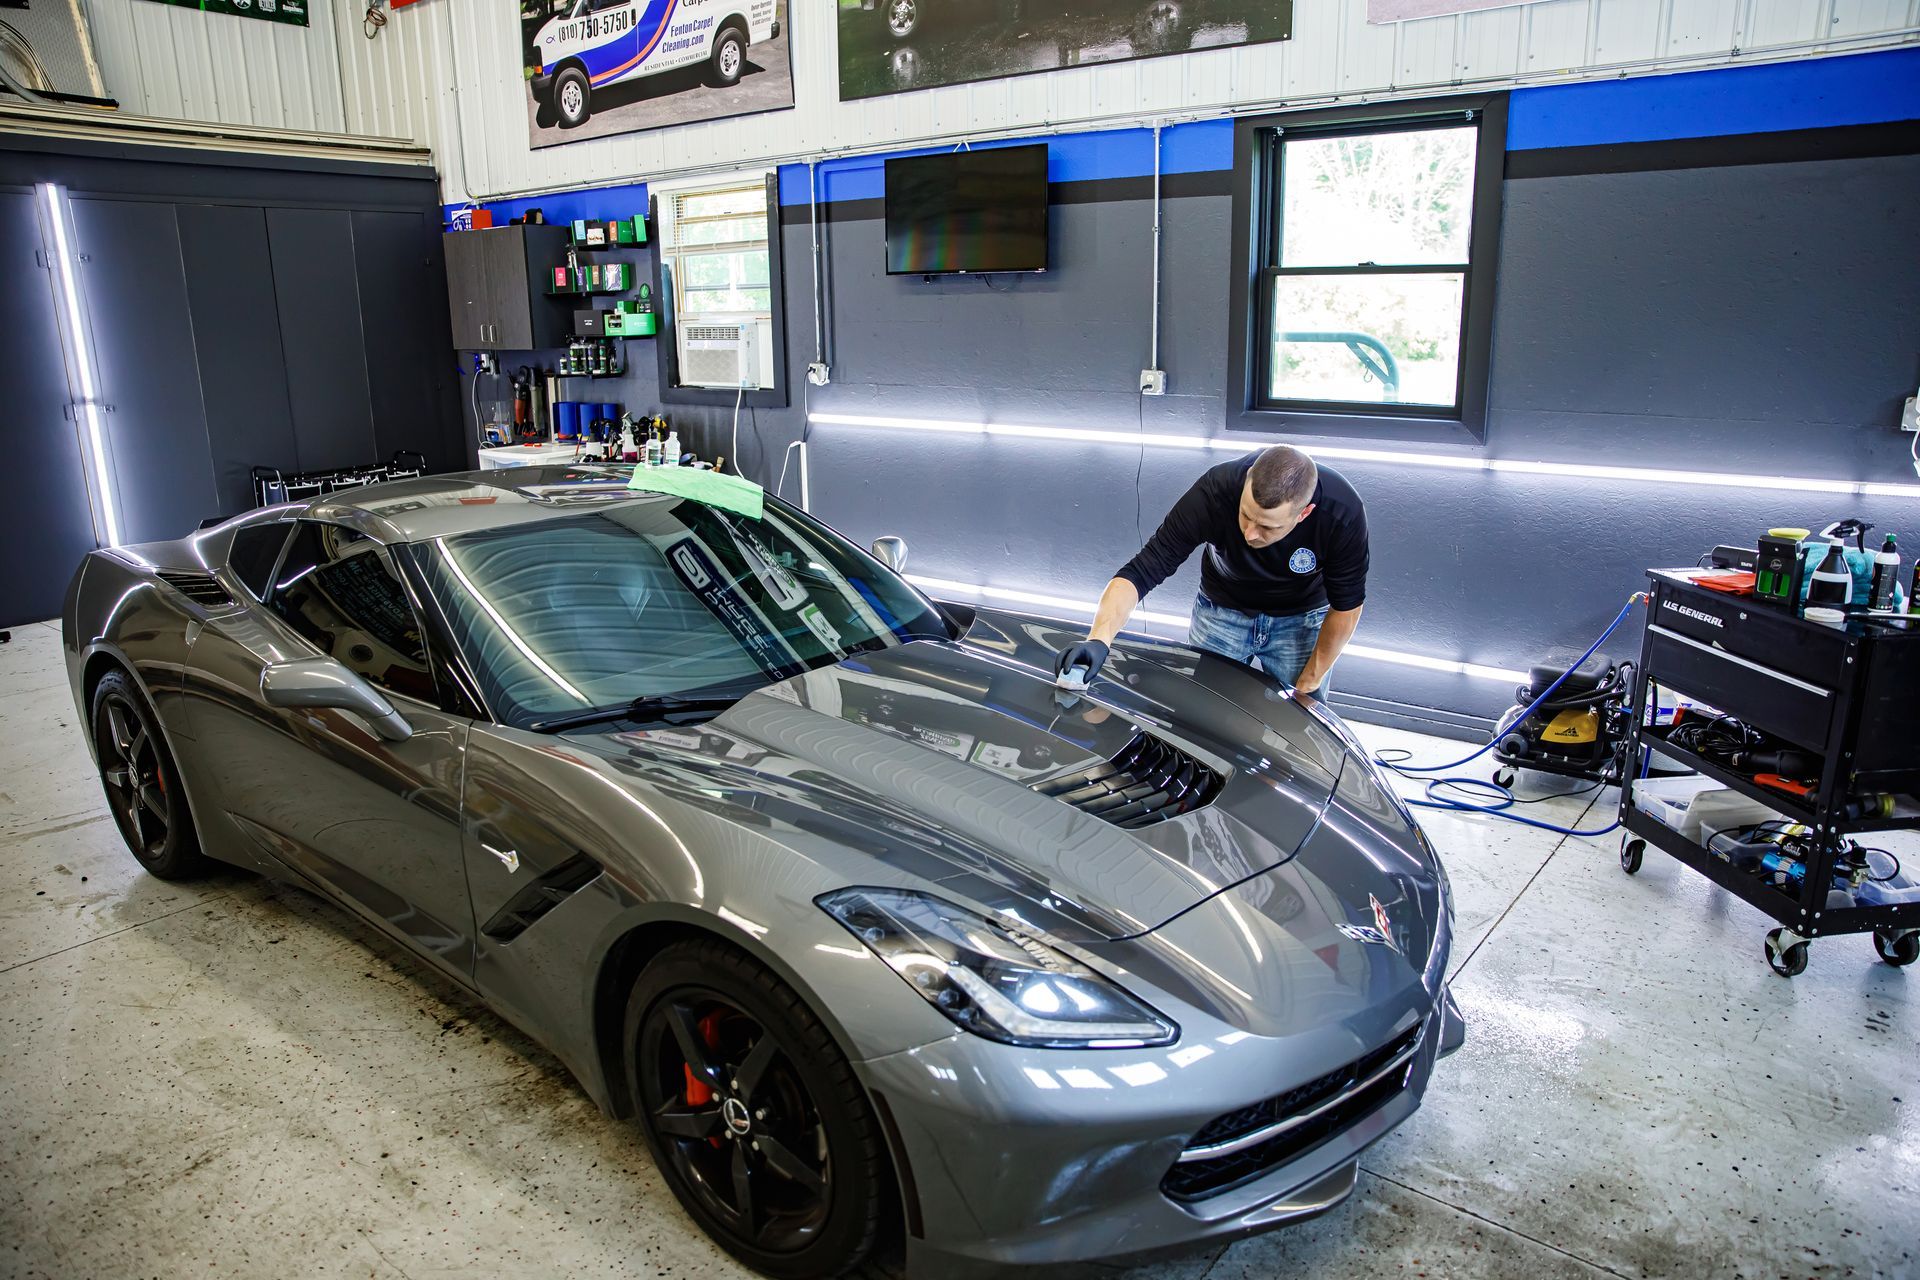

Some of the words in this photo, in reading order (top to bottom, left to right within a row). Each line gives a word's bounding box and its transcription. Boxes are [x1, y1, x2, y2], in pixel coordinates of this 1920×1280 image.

[558, 23, 578, 43] (810)
[580, 10, 628, 40] 750-5750
[662, 34, 704, 53] Cleaning.com
[1679, 605, 1724, 628] GENERAL
